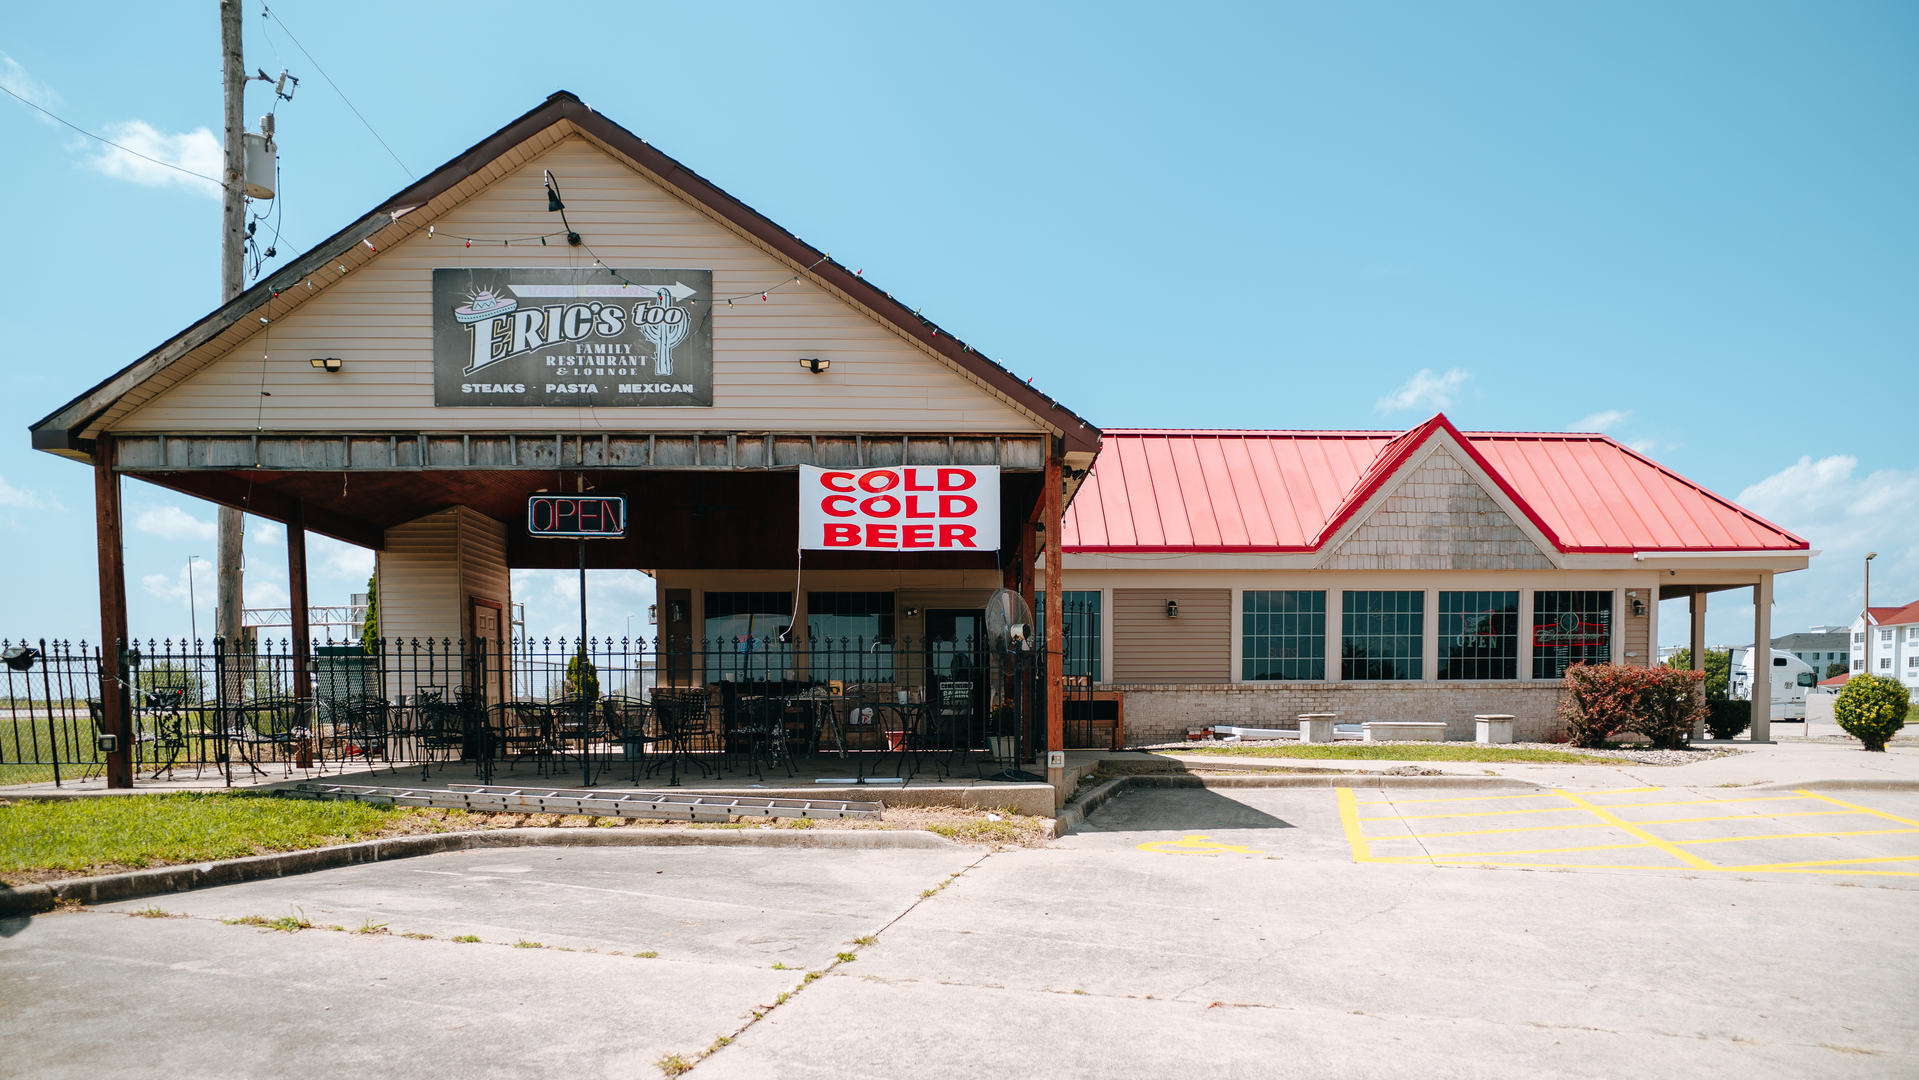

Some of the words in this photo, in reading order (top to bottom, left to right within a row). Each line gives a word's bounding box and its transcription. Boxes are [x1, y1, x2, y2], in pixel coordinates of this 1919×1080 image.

[527, 286, 577, 296] VIDEO
[584, 286, 650, 296] GAMING
[632, 301, 684, 326] too
[576, 343, 633, 355] FAMILY
[545, 355, 648, 366] RESTAURANT
[556, 367, 570, 376] &
[461, 383, 526, 394] STEAKS
[545, 383, 599, 394] PASTA
[618, 383, 694, 394] MEXICAN
[820, 468, 977, 494] COLD
[821, 494, 978, 519] COLD
[533, 499, 623, 532] OPEN
[823, 523, 977, 549] BEER
[1456, 634, 1498, 649] OPEN
[1269, 647, 1298, 659] SLOTS
